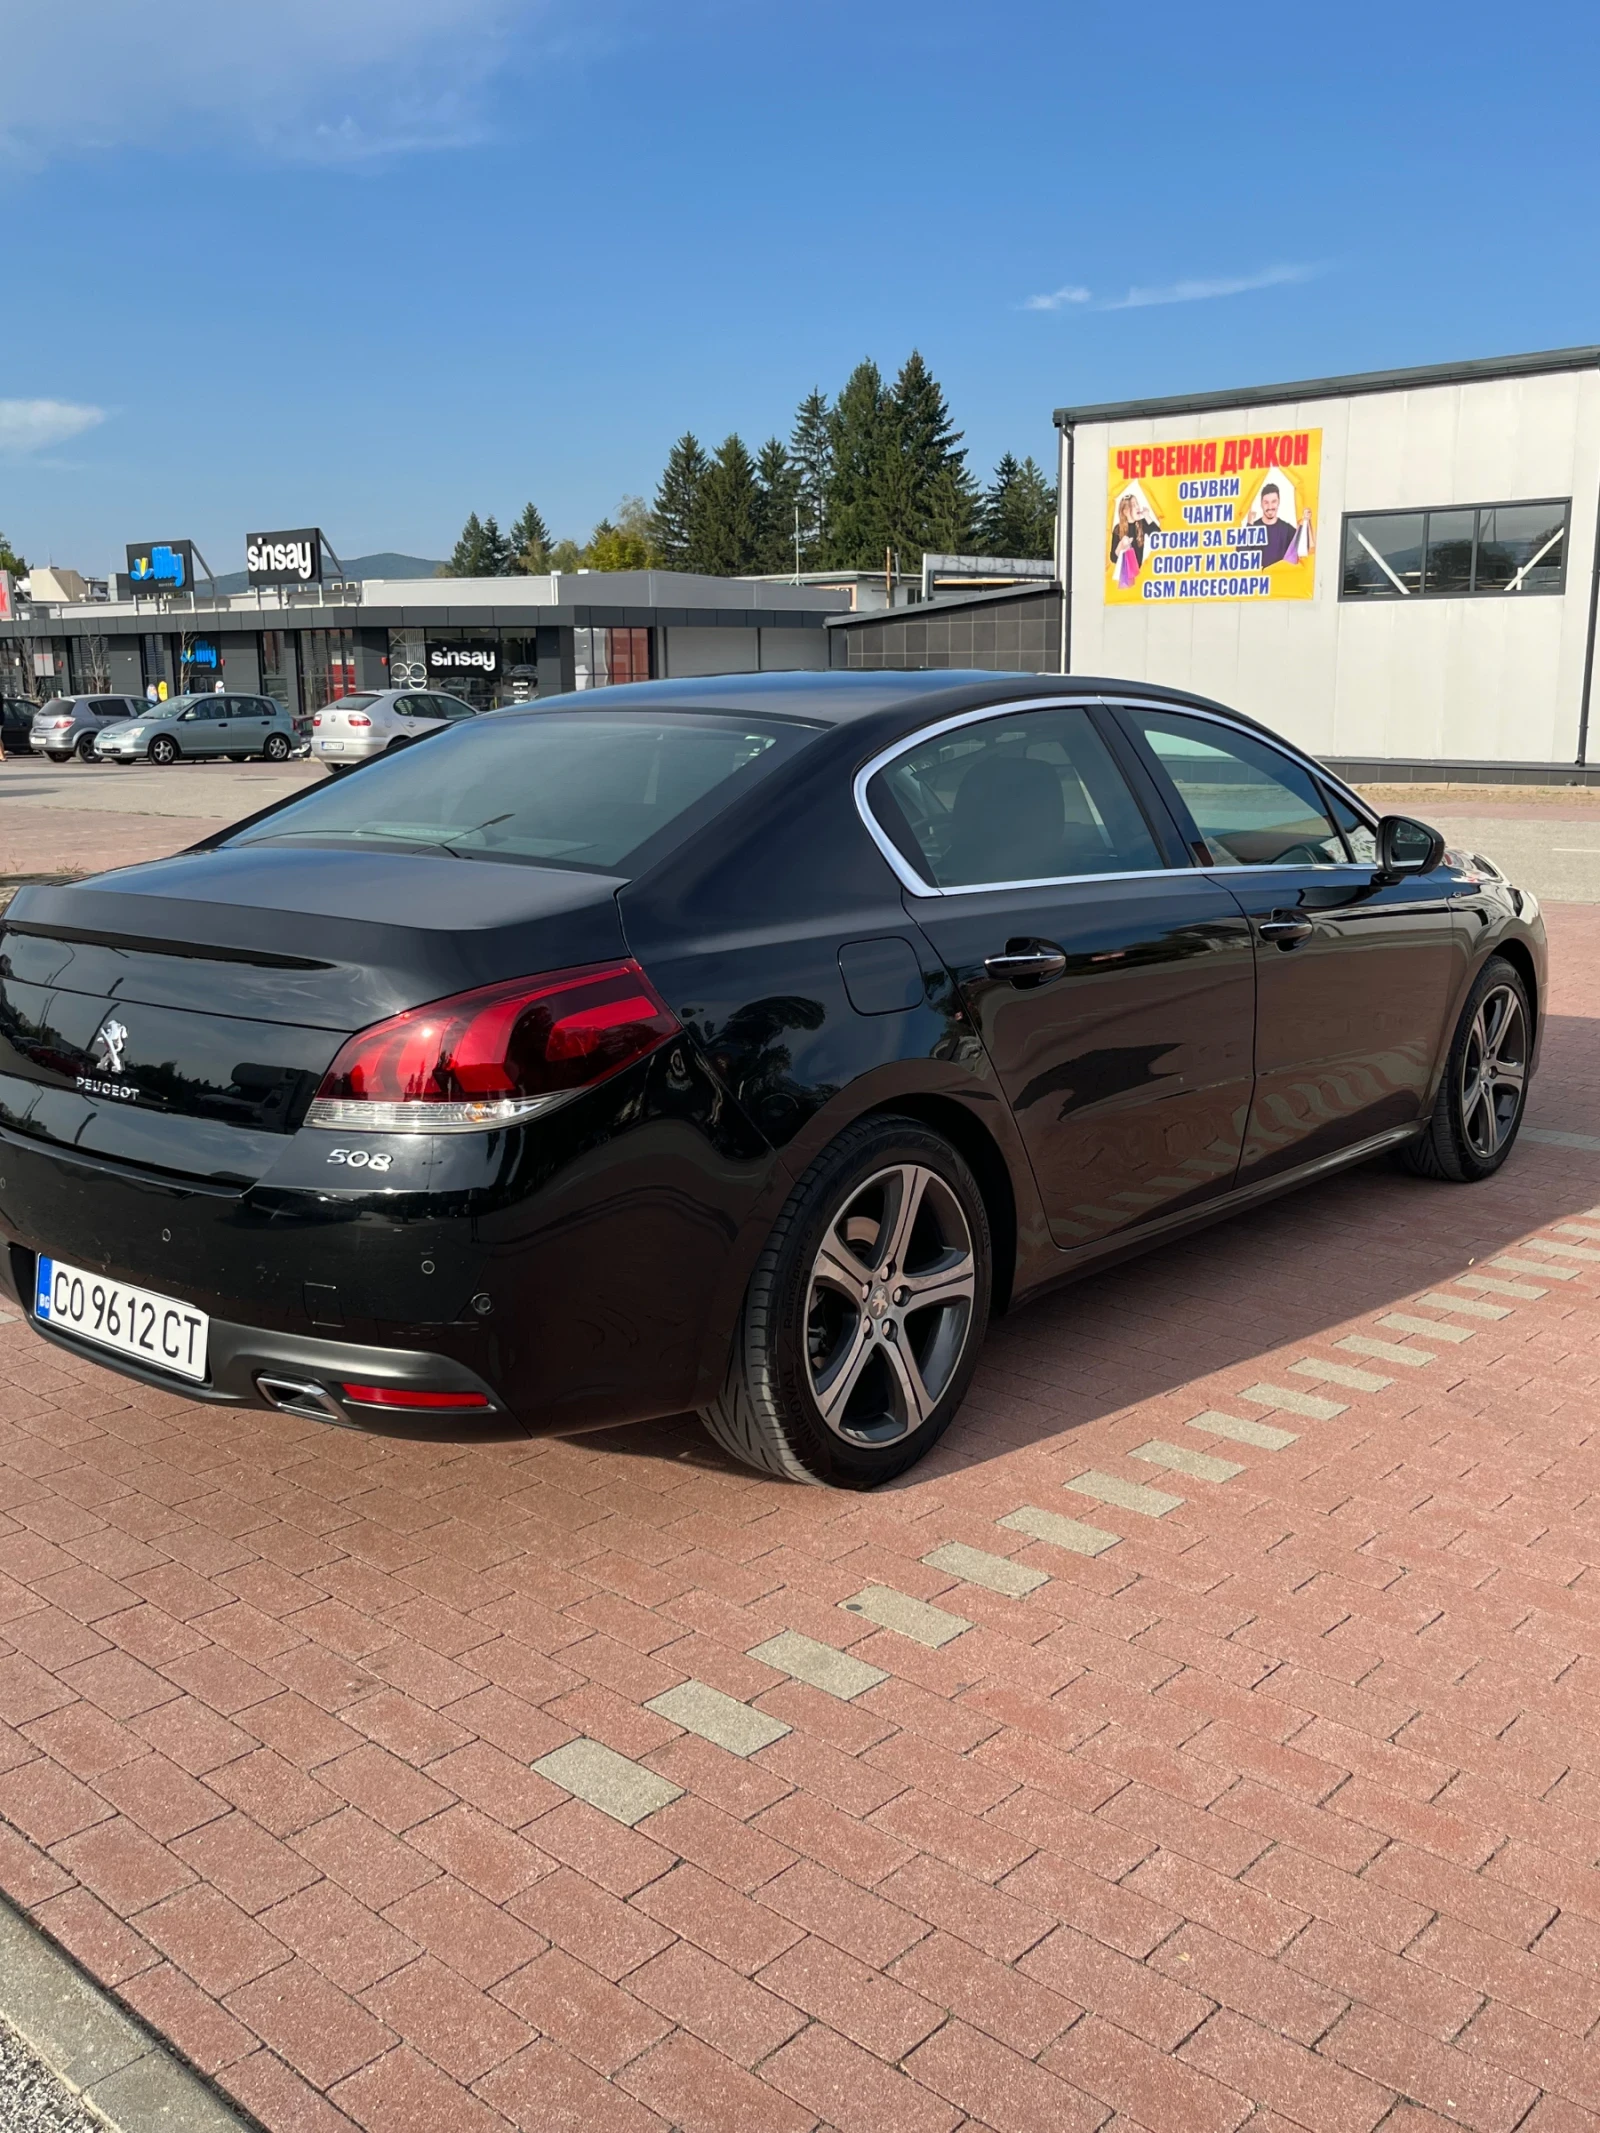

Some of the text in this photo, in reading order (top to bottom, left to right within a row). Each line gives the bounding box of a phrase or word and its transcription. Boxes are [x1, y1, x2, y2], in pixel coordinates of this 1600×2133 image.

[1116, 434, 1309, 480] ЧЕРВЕНИЯ ДРАКОН
[1179, 478, 1240, 500] ОБУВКИ
[1183, 504, 1233, 524] ЧАНТИ
[1150, 527, 1267, 550] СТОКИ ЗА БИТА
[247, 537, 312, 579] sinsay
[1153, 552, 1261, 574] СПОРТ И ХОБИ
[1143, 577, 1270, 598] GSM АКСЕСОАРИ
[430, 646, 497, 672] sinsay
[76, 1076, 140, 1101] PEUGEOT
[326, 1148, 393, 1173] 508
[38, 1292, 50, 1310] BG
[783, 1362, 821, 1450] UNIROYAL
